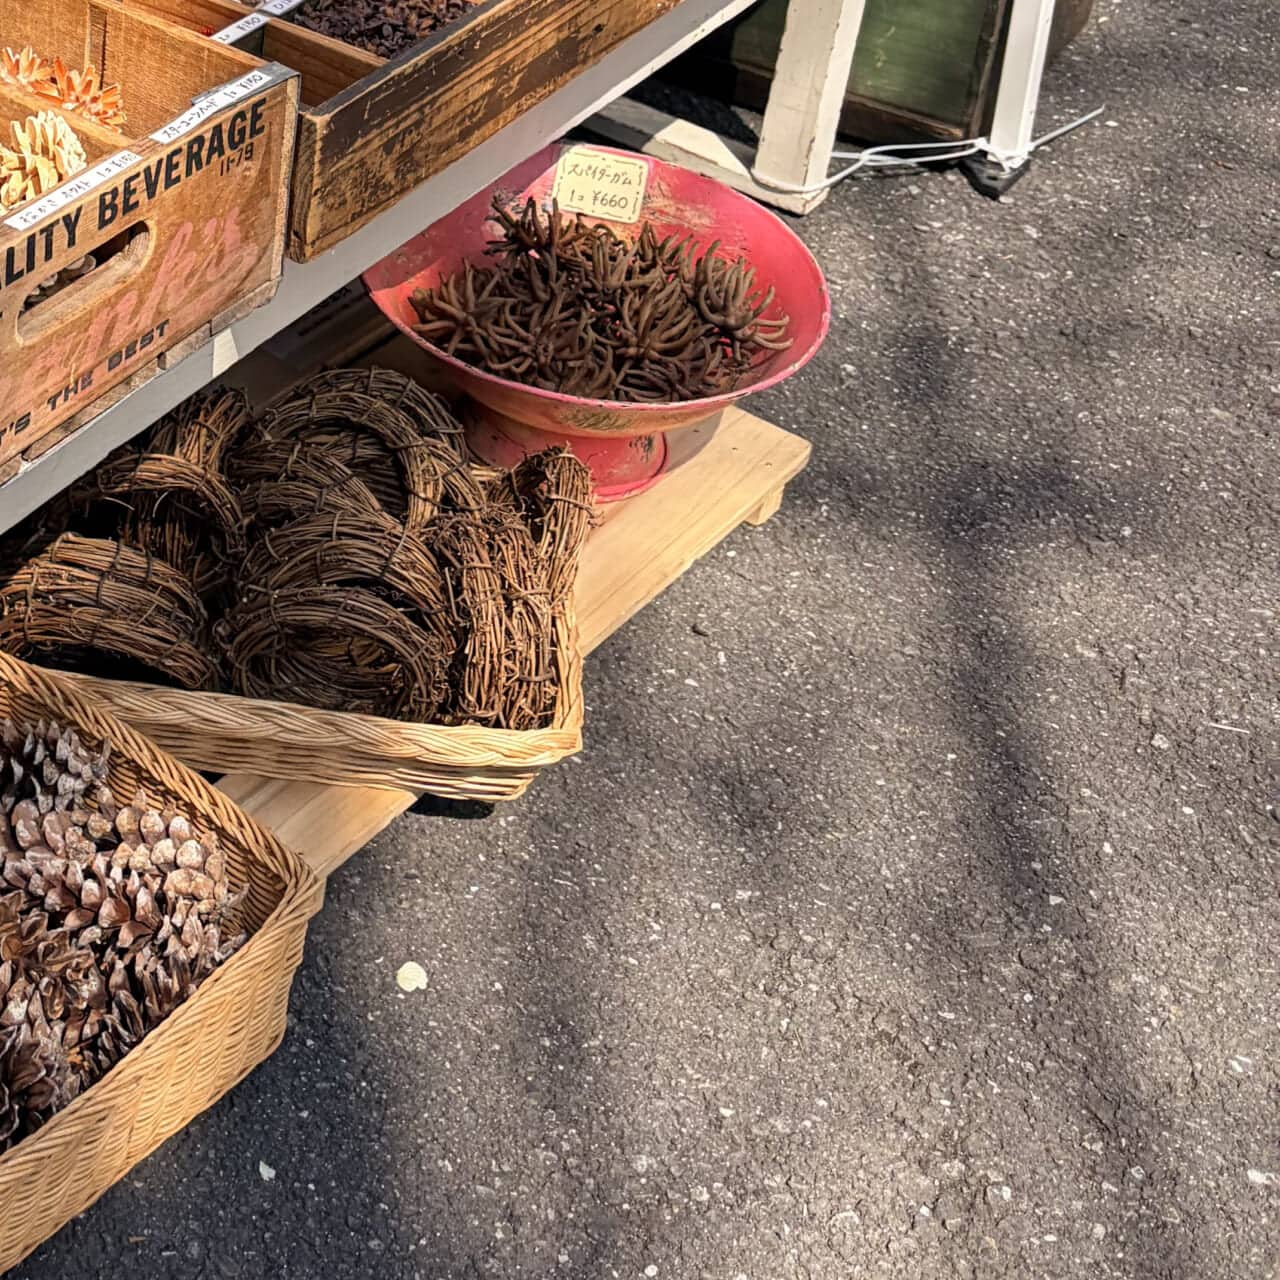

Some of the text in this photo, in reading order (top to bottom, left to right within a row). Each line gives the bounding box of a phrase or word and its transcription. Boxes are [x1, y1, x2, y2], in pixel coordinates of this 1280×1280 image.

[97, 97, 267, 230] BEVERAGE
[567, 163, 632, 185] スパイダーガム
[591, 189, 629, 209] ¥660
[46, 369, 94, 412] THE
[106, 318, 170, 373] BEST
